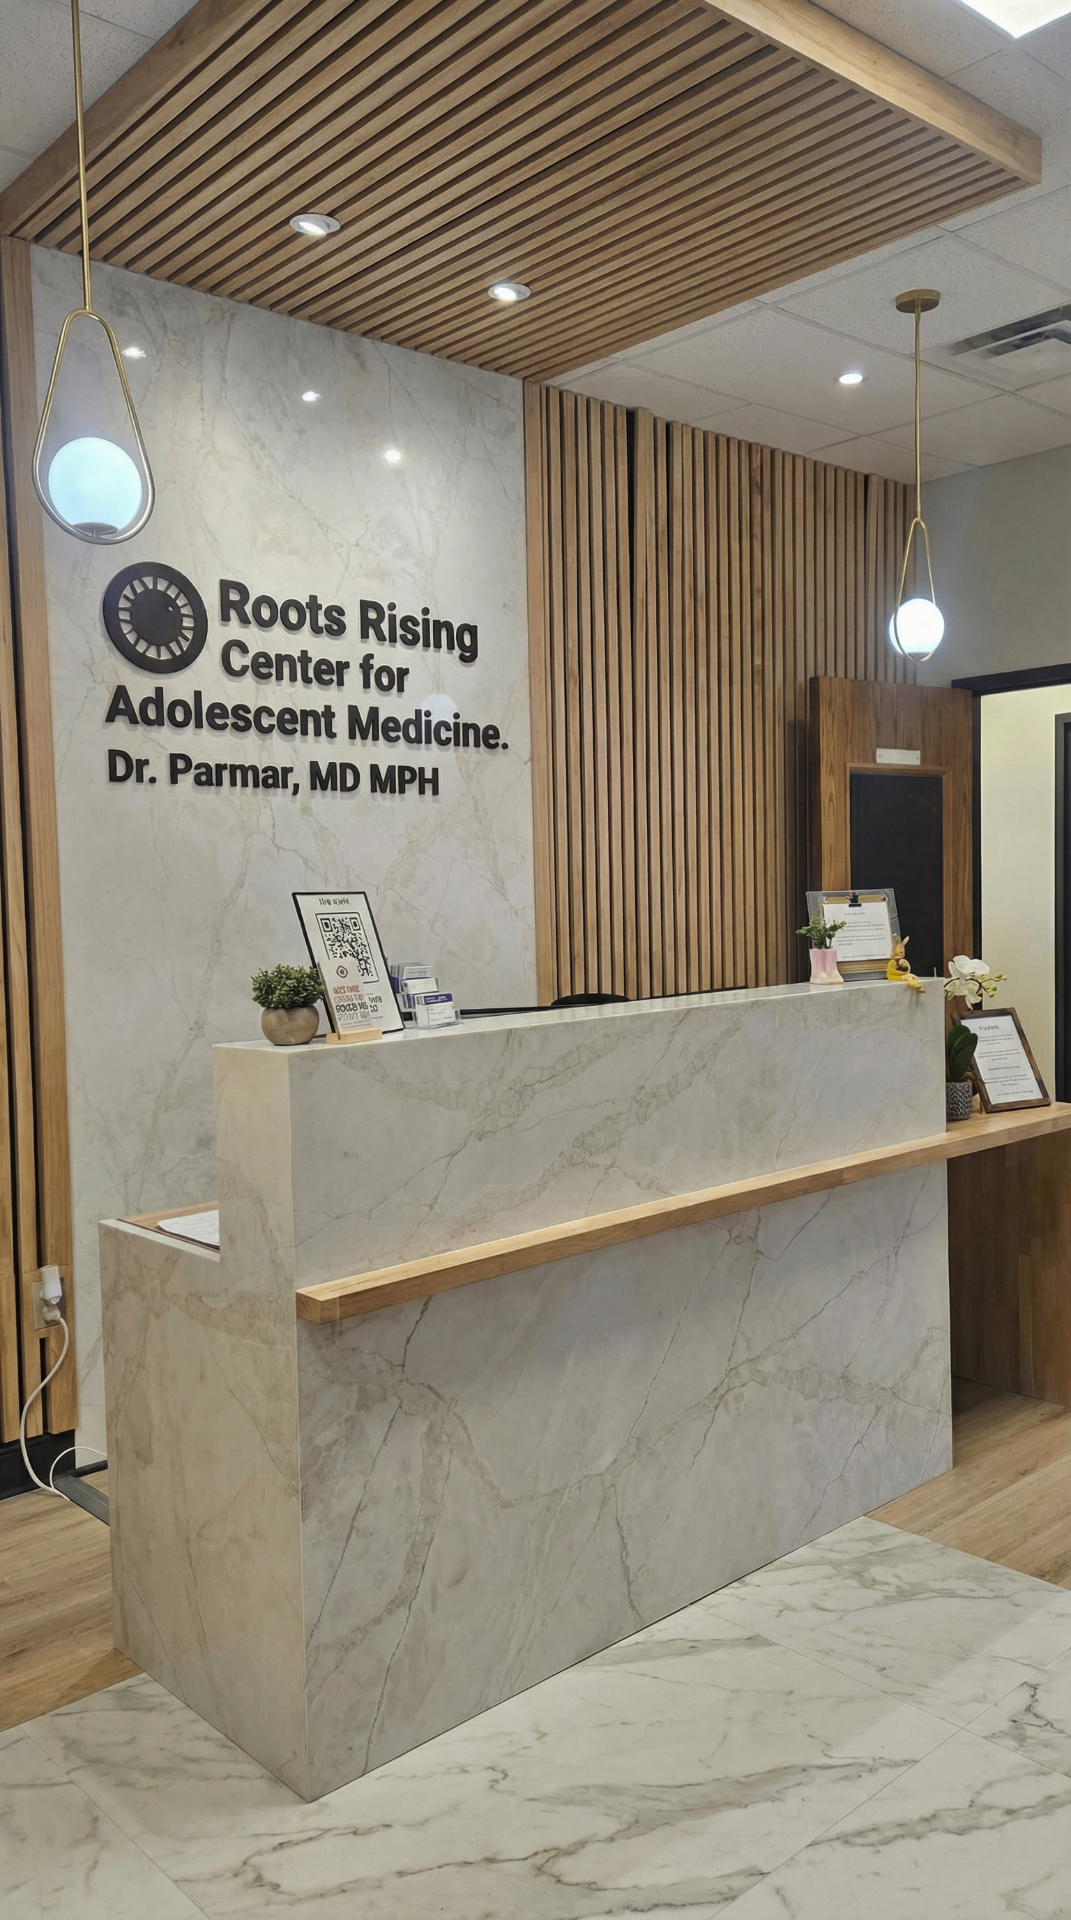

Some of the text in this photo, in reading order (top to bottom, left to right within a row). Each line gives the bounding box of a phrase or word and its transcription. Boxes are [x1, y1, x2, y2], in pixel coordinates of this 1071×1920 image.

[219, 578, 479, 664] Roots Rising
[221, 639, 410, 693] Center for
[104, 684, 510, 750] Adolescent Medicine.
[107, 748, 441, 797] Dr. Parmar, MD MPH
